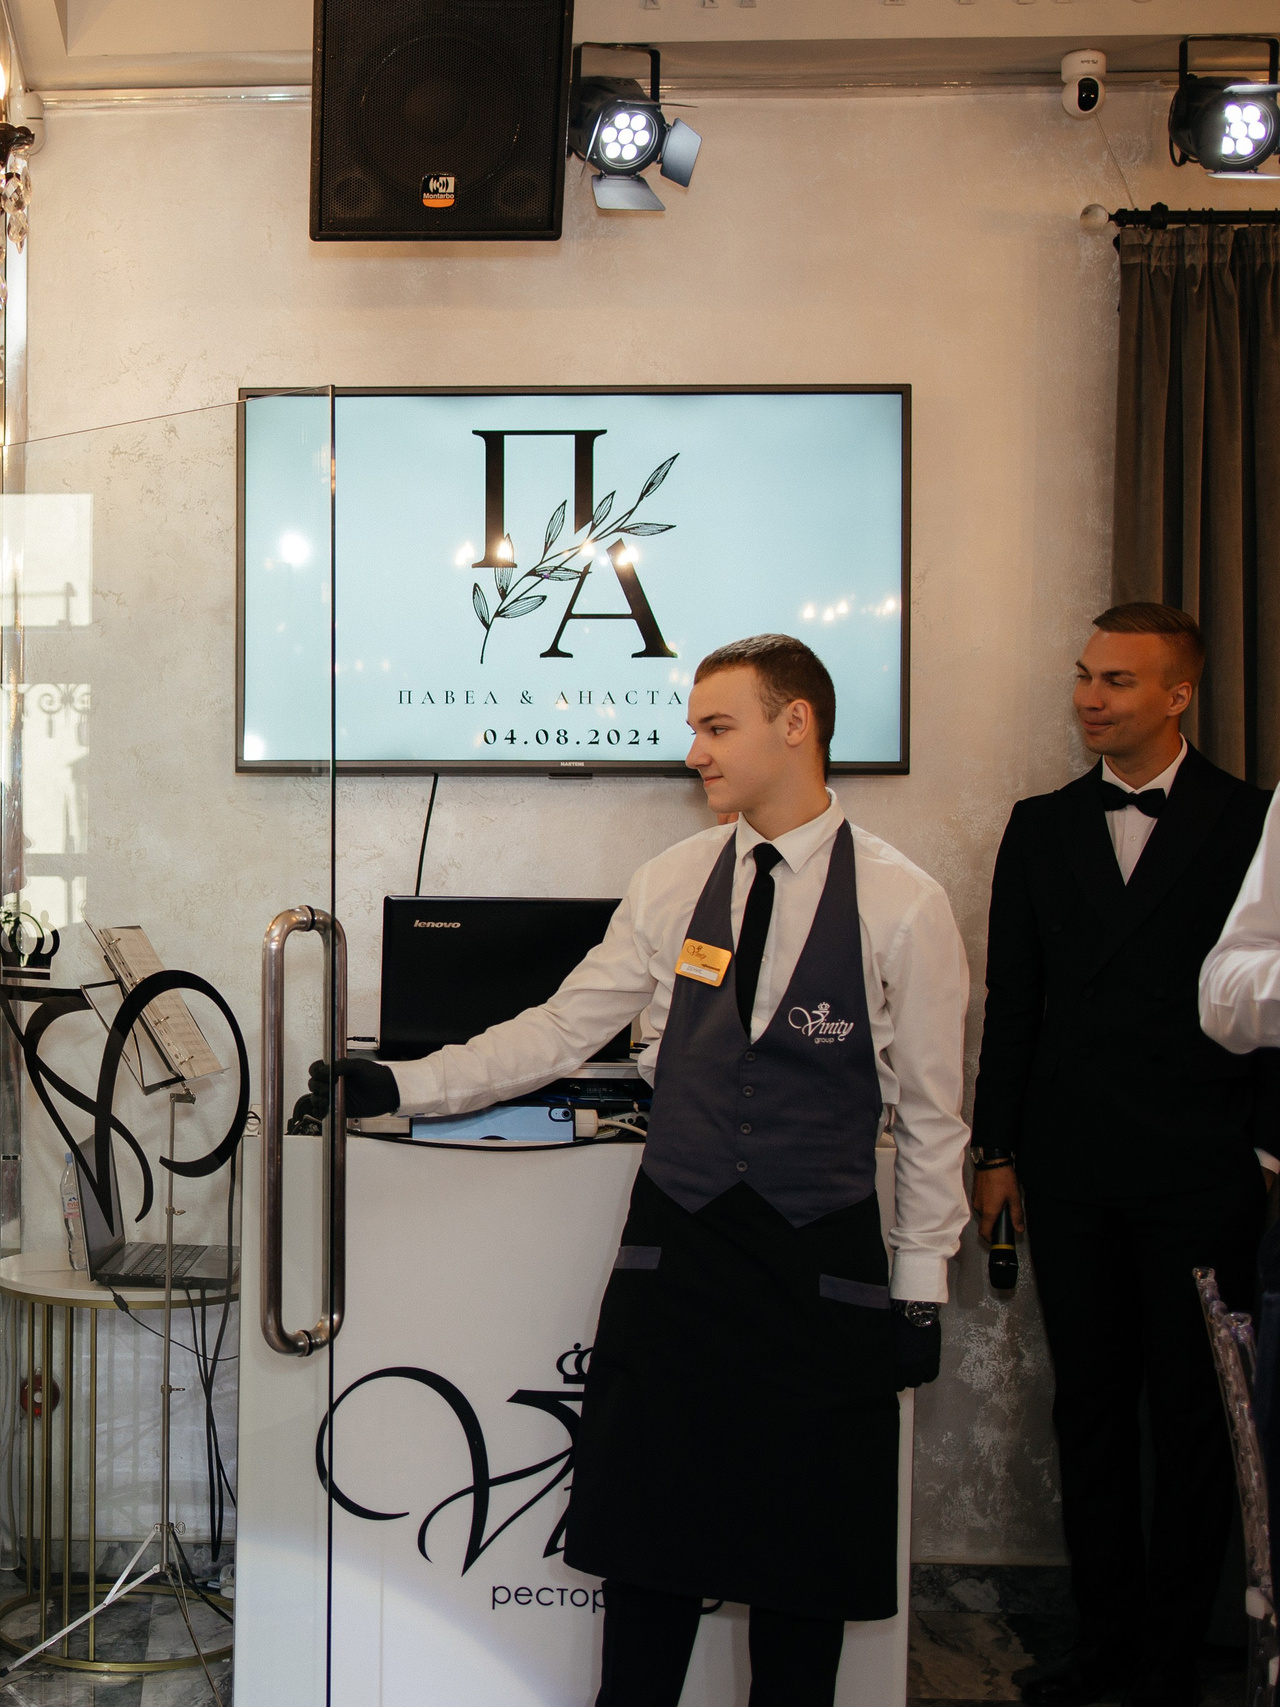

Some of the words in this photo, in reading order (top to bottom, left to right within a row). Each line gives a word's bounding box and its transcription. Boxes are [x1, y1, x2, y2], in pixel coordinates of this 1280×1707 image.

[398, 690, 498, 705] ПАВЕЛ
[520, 690, 534, 705] &
[483, 729, 660, 745] 04.08.2024
[414, 920, 461, 928] lenovo
[788, 1007, 854, 1042] Vinity
